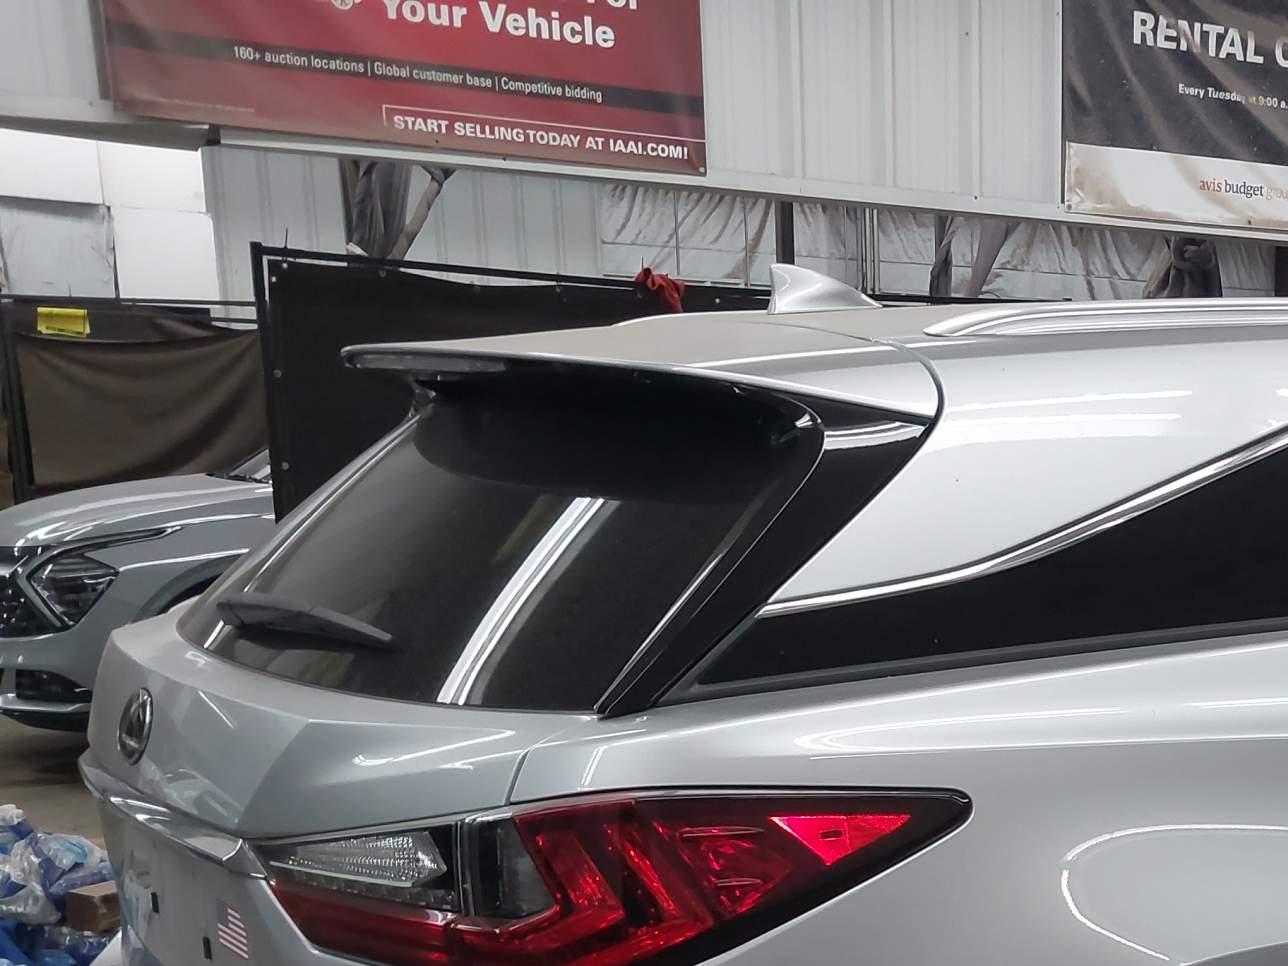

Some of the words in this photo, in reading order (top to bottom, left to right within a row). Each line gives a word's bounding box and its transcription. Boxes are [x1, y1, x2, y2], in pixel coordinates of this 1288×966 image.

[383, 0, 467, 28] Your
[478, 1, 615, 48] Vehicle
[1133, 10, 1264, 64] RENTAL
[234, 46, 261, 61] 160+
[265, 51, 308, 67] auction
[311, 55, 365, 73] locations
[374, 61, 410, 78] Global
[413, 69, 463, 84] customer
[466, 73, 492, 88] base
[501, 77, 563, 96] Competitive
[565, 85, 602, 103] bidding
[1178, 83, 1205, 98] Every
[1207, 87, 1246, 105] Tuesday
[1258, 95, 1278, 108] 9:00
[393, 115, 449, 134] START
[454, 122, 524, 142] SELLING
[526, 130, 580, 148] TODAY
[585, 137, 605, 151] AT
[609, 138, 689, 159] IAAI.COM!
[1199, 178, 1222, 193] avis
[1224, 179, 1264, 199] budget
